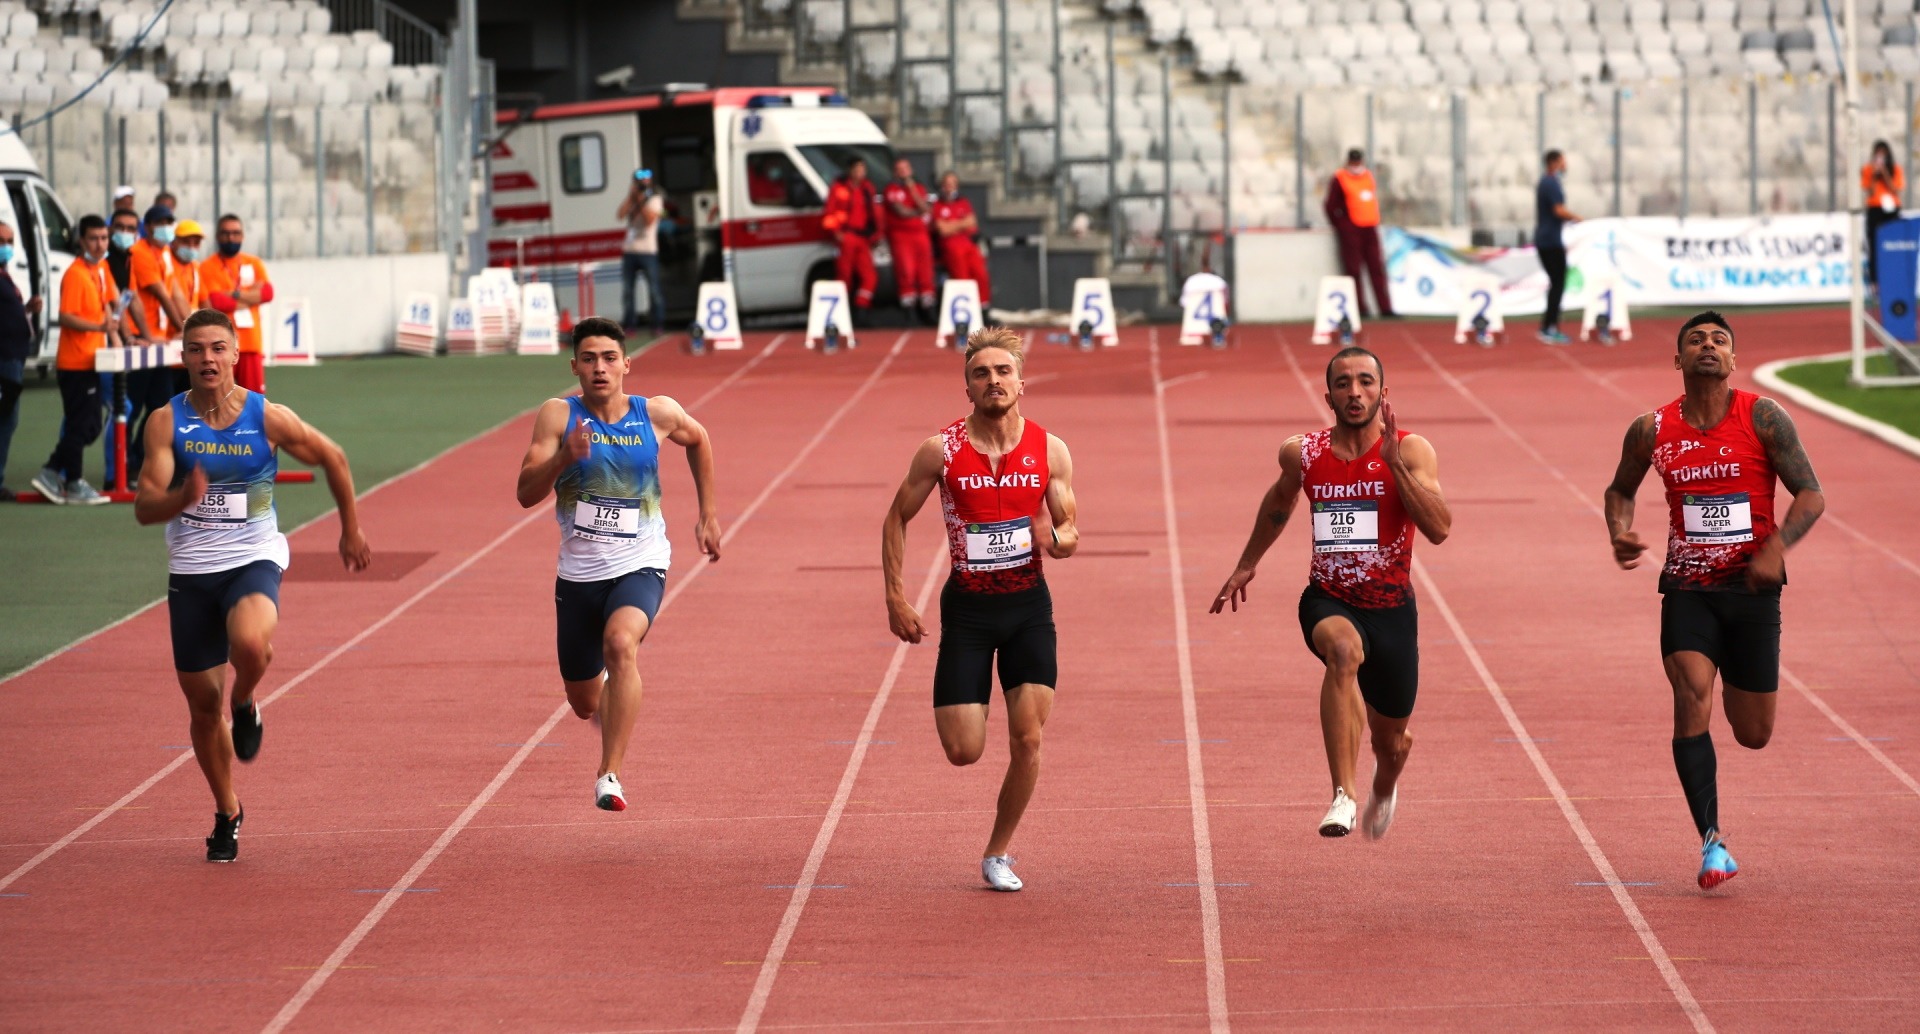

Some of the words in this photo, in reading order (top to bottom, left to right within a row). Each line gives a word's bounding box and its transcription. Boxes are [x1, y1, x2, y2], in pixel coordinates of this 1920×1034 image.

[818, 295, 840, 324] 7
[950, 294, 972, 326] 6
[1081, 293, 1104, 327] 5
[1192, 290, 1214, 323] 4
[1327, 290, 1348, 327] 3
[1469, 289, 1492, 321] 2
[1597, 288, 1612, 322] 1
[706, 297, 728, 332] 8
[284, 310, 299, 348] 1
[184, 440, 253, 456] ROMANIA
[581, 432, 643, 446] ROMANIA
[958, 472, 1040, 490] TÜRKİYE
[1671, 462, 1740, 483] TÜRKİYE
[1312, 480, 1385, 498] TÜRKİYE
[200, 494, 225, 506] 158
[196, 505, 230, 514] ROIBAN
[595, 507, 620, 519] 175
[1330, 512, 1355, 525] 216
[1700, 505, 1730, 519] 220
[593, 518, 619, 528] BIRSA
[1702, 519, 1731, 527] SAFER
[988, 531, 1013, 546] 217
[986, 544, 1017, 555] OZKAN
